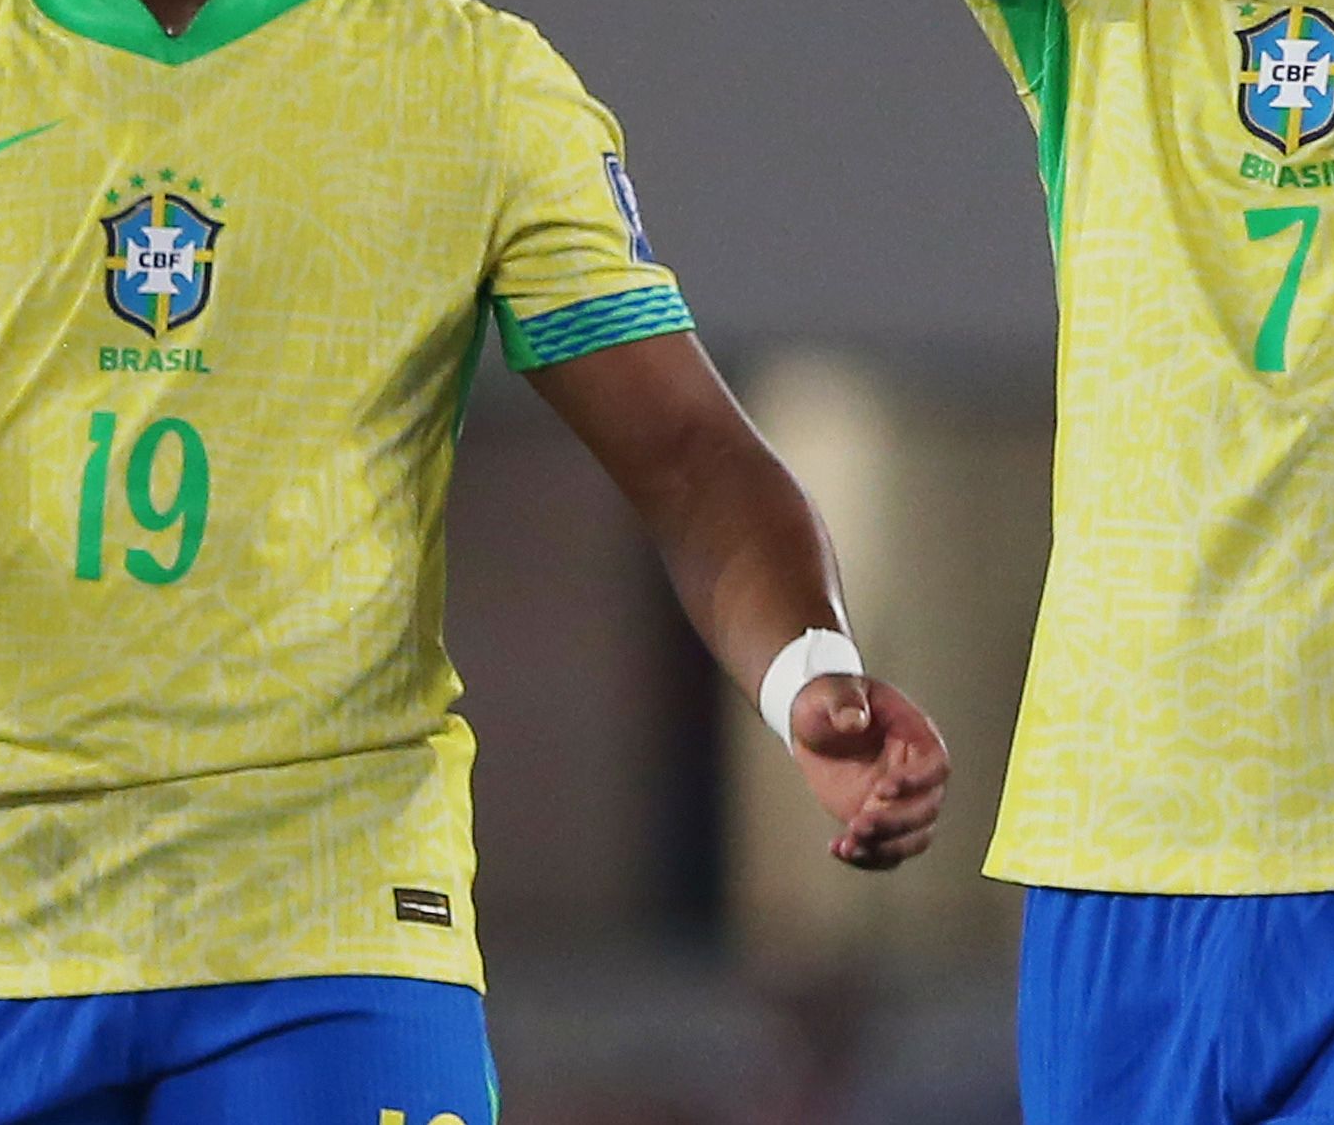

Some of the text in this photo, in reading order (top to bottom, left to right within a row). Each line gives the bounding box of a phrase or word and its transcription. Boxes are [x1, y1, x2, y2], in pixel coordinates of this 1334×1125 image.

[1272, 65, 1317, 83] CBF
[139, 253, 181, 269] CBF
[1244, 206, 1320, 372] 7
[99, 346, 211, 373] BRASIL
[75, 411, 210, 585] 19
